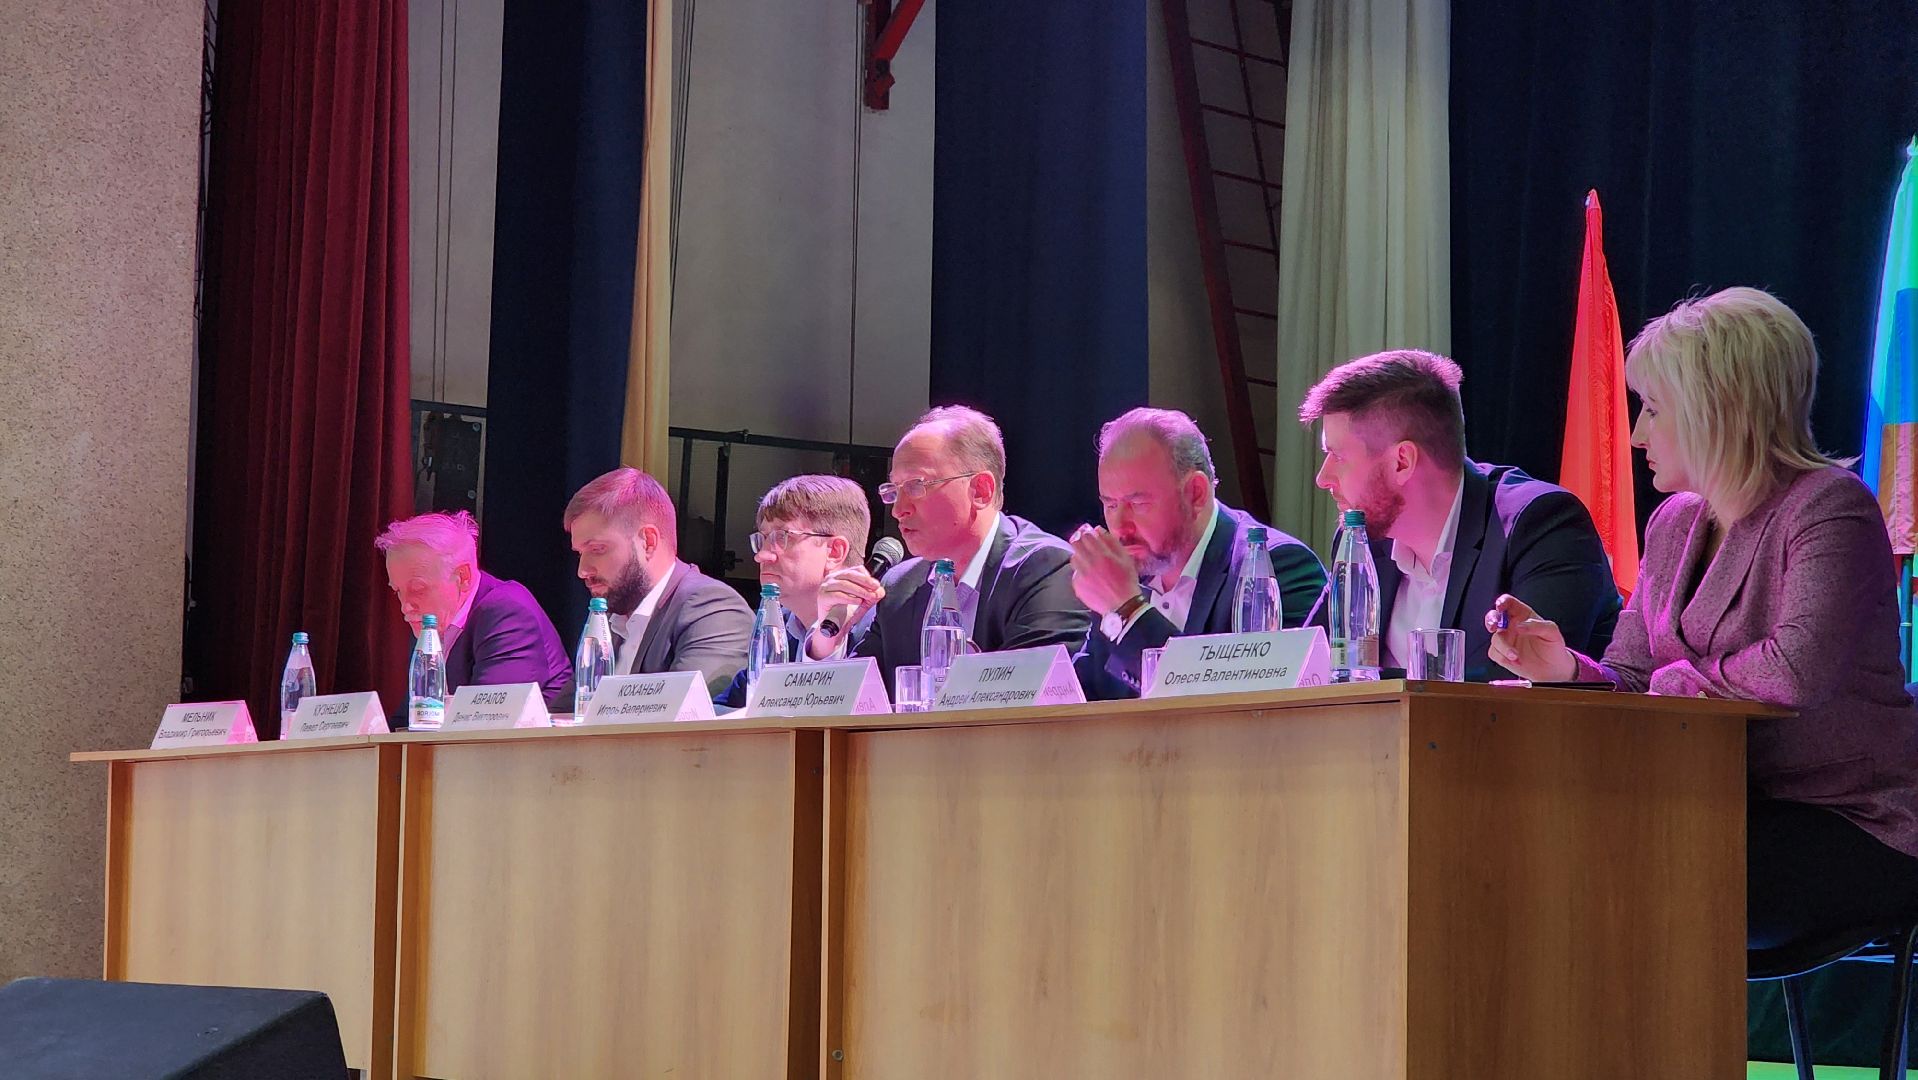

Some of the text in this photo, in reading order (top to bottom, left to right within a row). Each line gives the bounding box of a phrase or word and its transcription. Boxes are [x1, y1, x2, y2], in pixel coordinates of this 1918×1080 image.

[1200, 641, 1271, 662] ТЫЩЕНКО
[784, 670, 835, 688] САМАРИН
[978, 665, 1016, 683] ПУЛИН
[1164, 671, 1201, 686] Олеся
[1202, 666, 1288, 682] Валентиновна
[617, 680, 666, 698] КОХАНЫЙ
[971, 689, 1038, 705] Александрович
[758, 695, 803, 709] Александр
[804, 692, 845, 708] Юрьевич
[597, 704, 620, 716] Игорь
